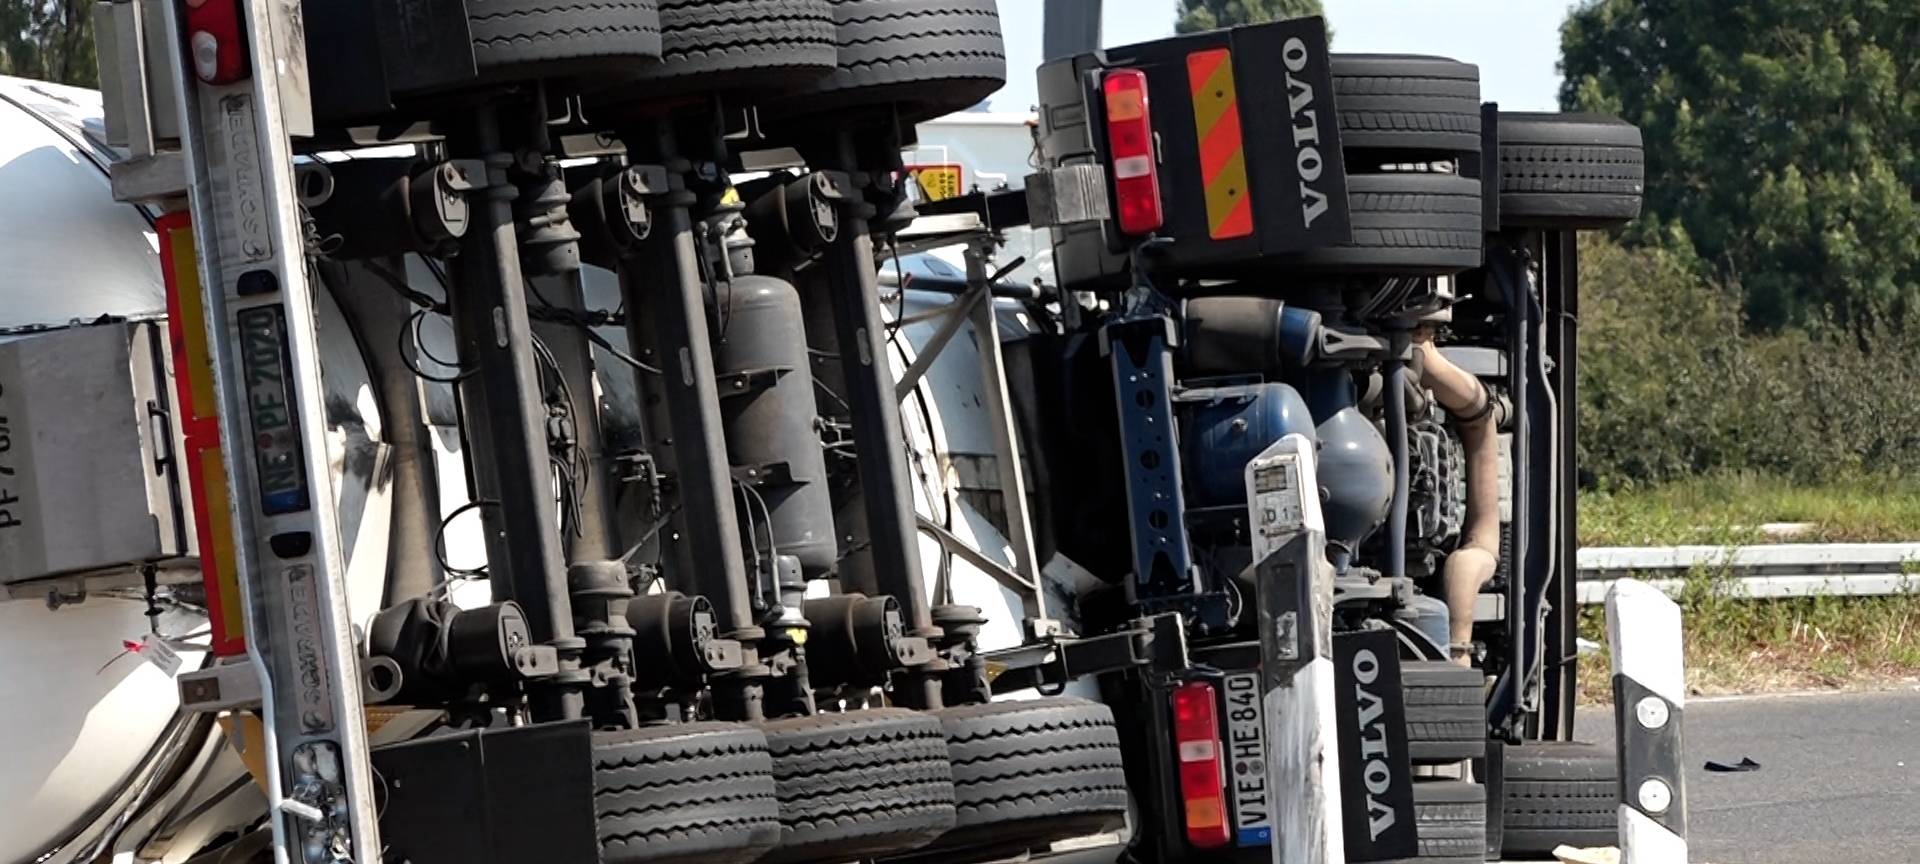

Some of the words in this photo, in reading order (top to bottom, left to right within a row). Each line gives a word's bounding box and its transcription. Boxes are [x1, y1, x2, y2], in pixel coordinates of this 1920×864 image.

[1282, 37, 1329, 228] VOLVO
[253, 390, 288, 431] PF
[261, 449, 298, 493] NE
[1227, 676, 1258, 722] 840
[1232, 726, 1261, 759] HE
[1353, 649, 1395, 841] VOLVO
[1237, 777, 1269, 827] VIE
